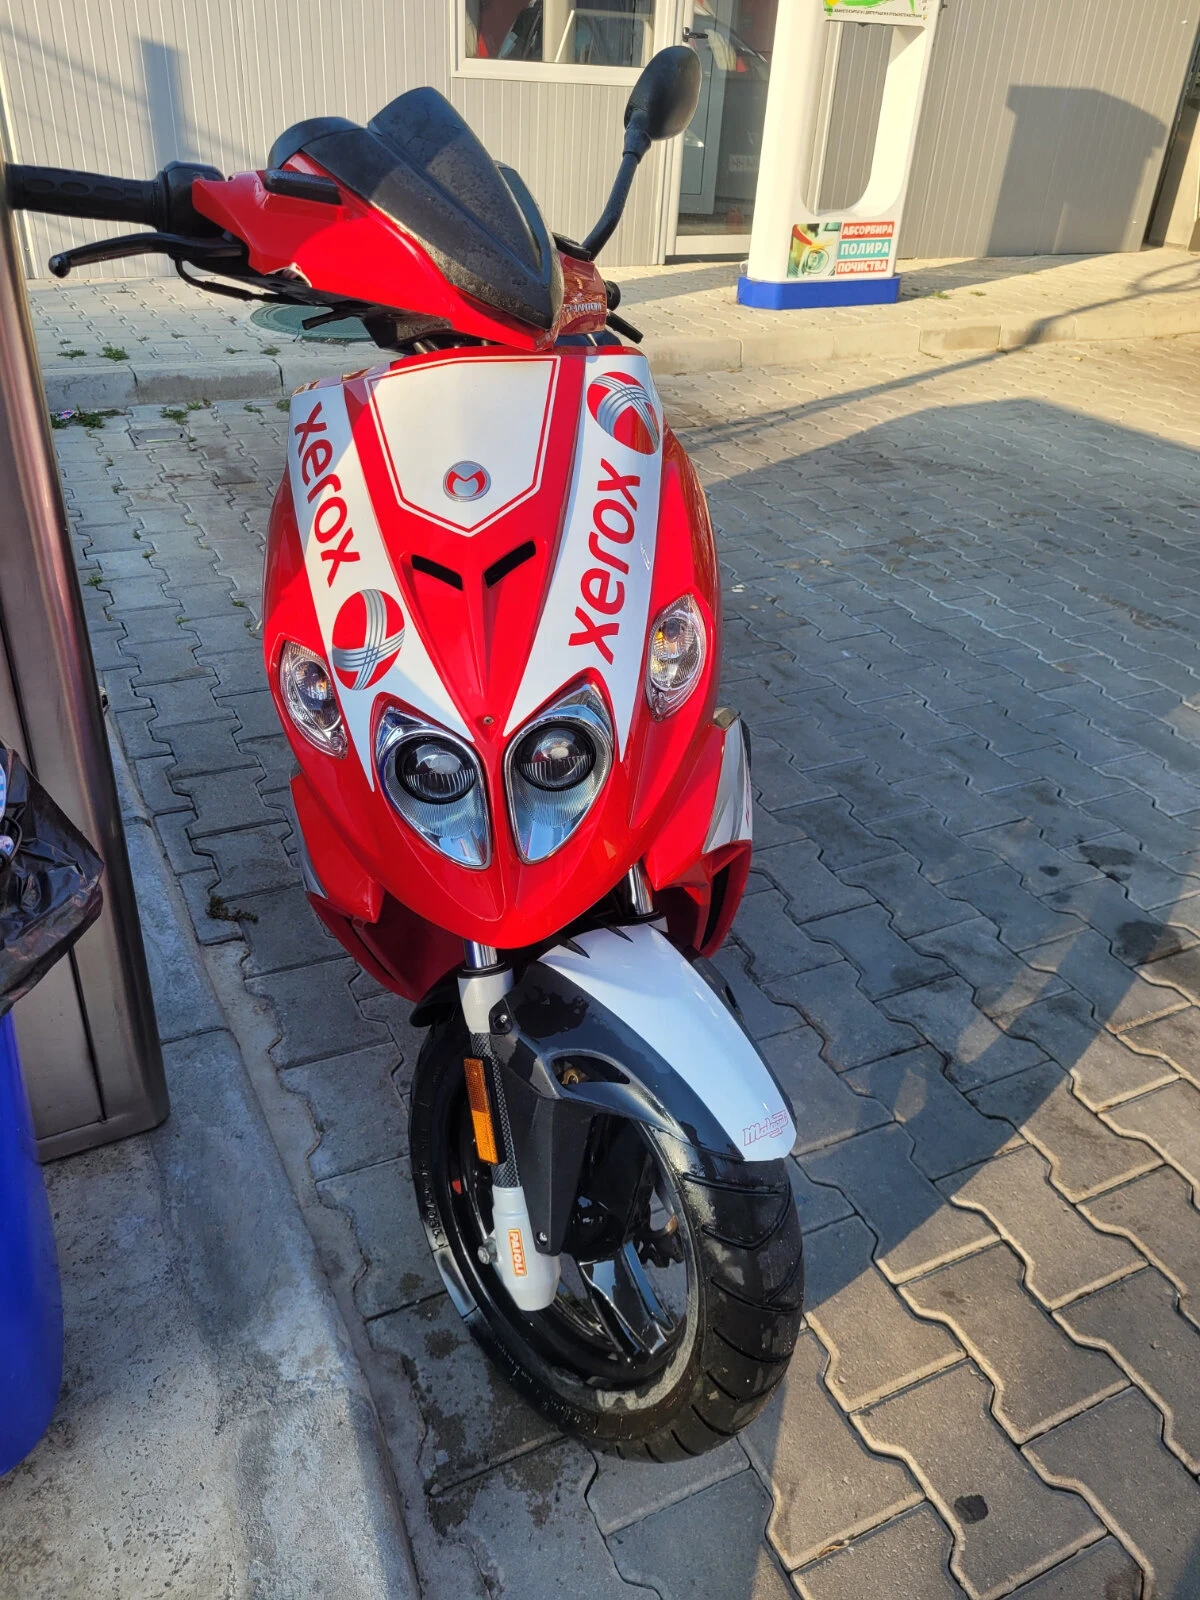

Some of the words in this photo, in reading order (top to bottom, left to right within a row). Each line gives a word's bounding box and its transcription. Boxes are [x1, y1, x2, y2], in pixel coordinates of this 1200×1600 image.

[843, 225, 893, 235] АБСОРБИРА
[841, 242, 889, 255] ПОЛИРА
[838, 261, 887, 272] ПОЧИСТВА
[294, 401, 360, 587] xerox
[568, 458, 641, 664] xerox
[510, 1232, 525, 1274] PAIOLI
